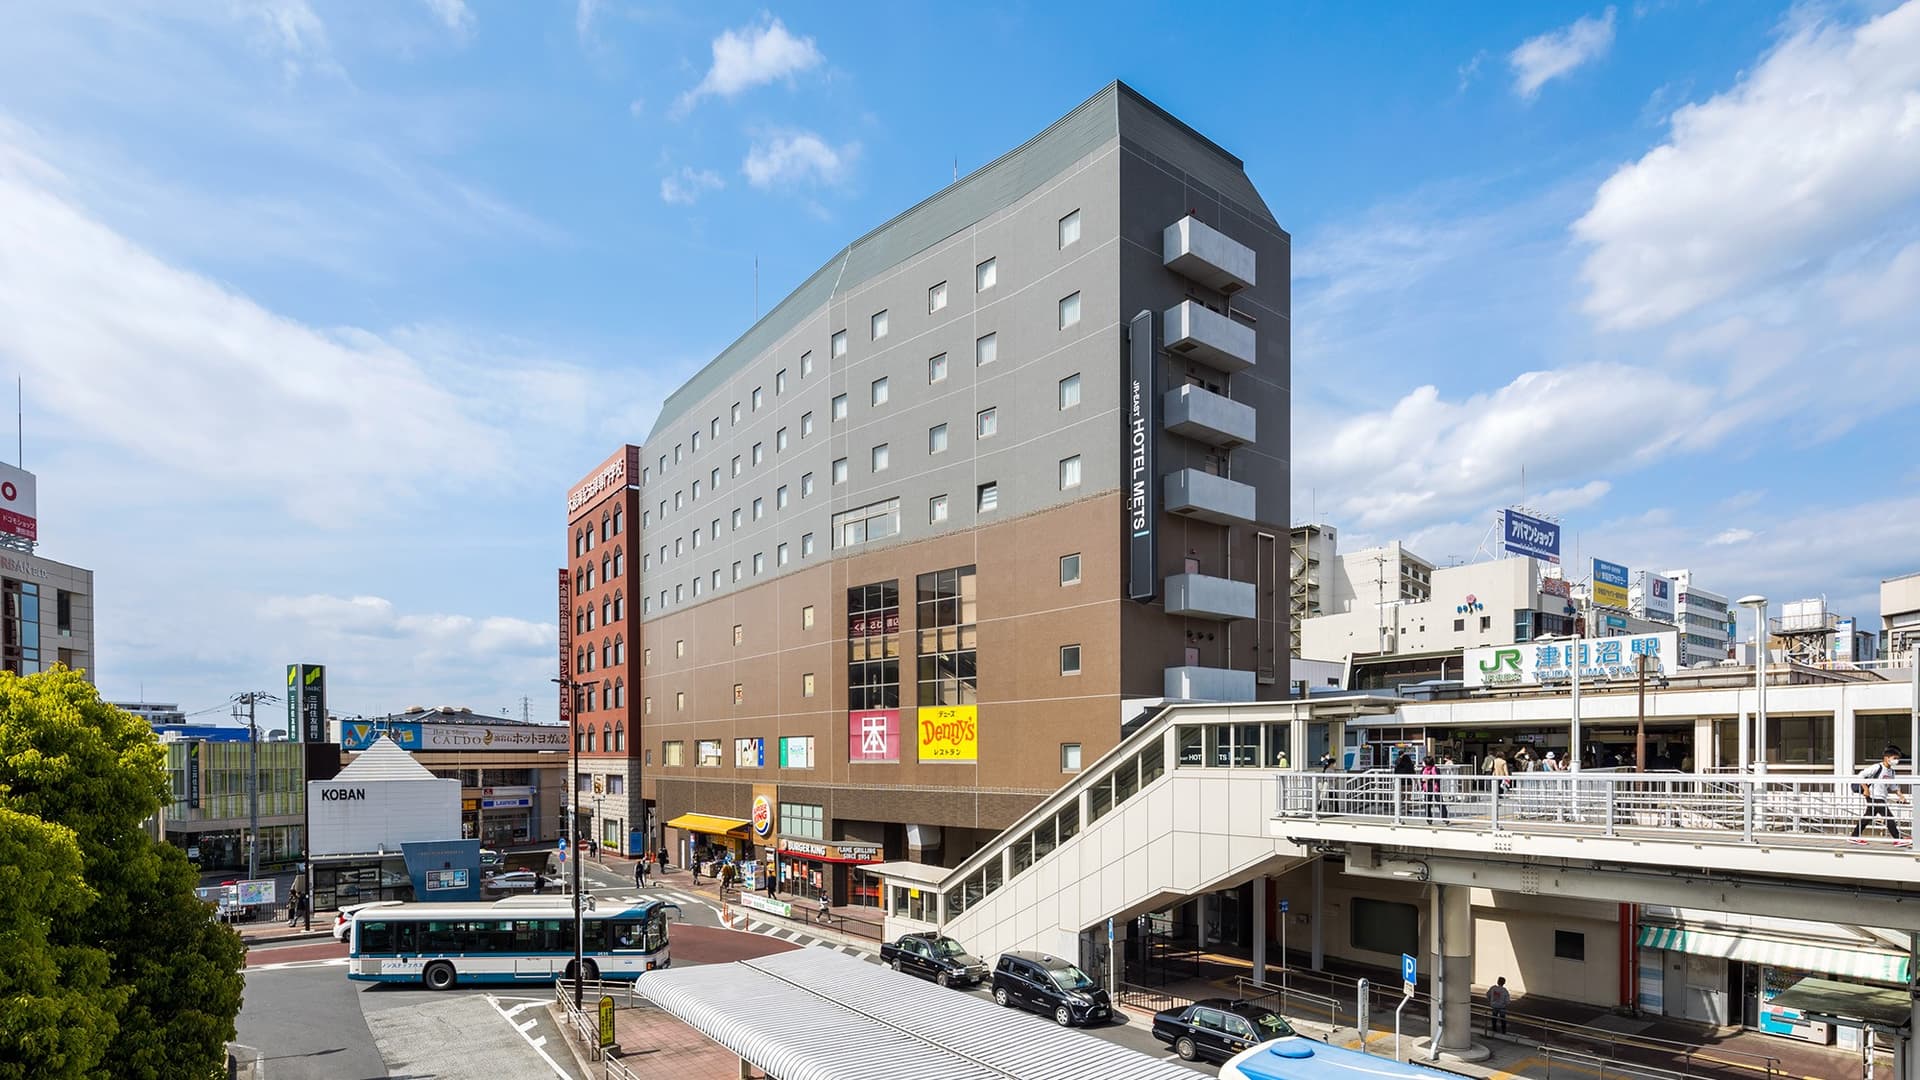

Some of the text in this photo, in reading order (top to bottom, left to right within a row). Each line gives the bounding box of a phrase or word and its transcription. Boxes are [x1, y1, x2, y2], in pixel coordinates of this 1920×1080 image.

[1133, 418, 1145, 480] HOTEL
[1133, 481, 1145, 530] METS
[1511, 520, 1555, 548] アパマンショップ
[1479, 649, 1521, 672] JR
[1535, 637, 1658, 668] 津田沼駅
[1531, 666, 1606, 679] TSUDAUMA
[938, 710, 956, 718] デニーズ
[432, 735, 481, 745] CALDO
[921, 716, 975, 746] Denny's
[933, 748, 961, 756] レストラン
[321, 788, 365, 801] KOBAN
[789, 841, 826, 856] BURGER KING
[1406, 958, 1413, 978] P
